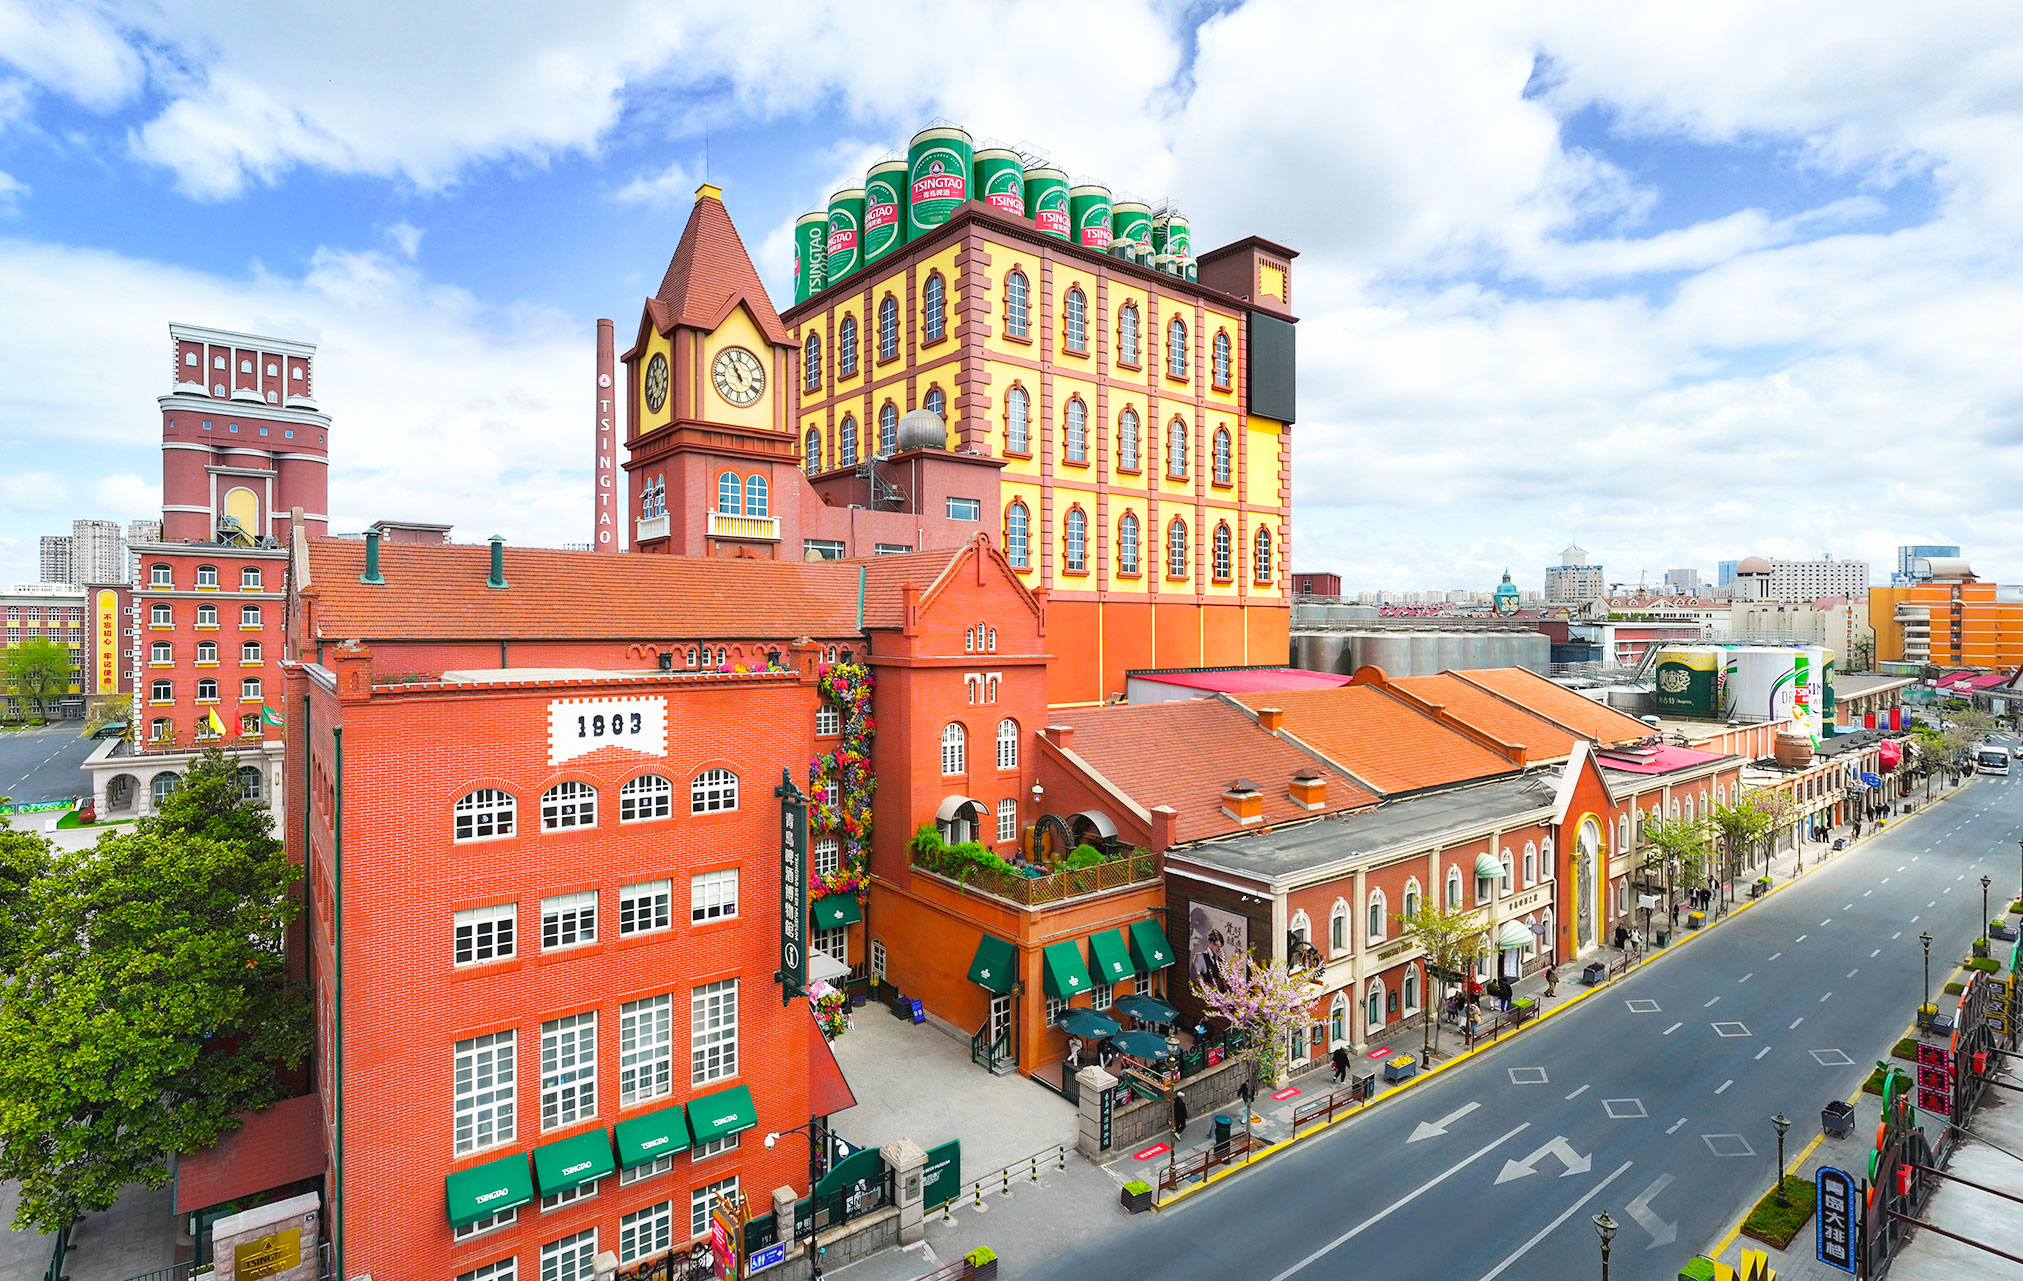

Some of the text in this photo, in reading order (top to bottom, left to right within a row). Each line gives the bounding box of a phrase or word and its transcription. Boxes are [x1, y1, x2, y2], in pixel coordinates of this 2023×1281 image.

[914, 178, 963, 193] TSINGTAO
[809, 227, 821, 296] TSINGTAO
[600, 399, 610, 544] TSINGTAO
[103, 613, 112, 684] 不忘初心 牢记使命
[578, 713, 641, 738] 1903
[712, 1113, 738, 1127] TSINGTAO
[641, 1136, 669, 1150] TSINGTAO
[562, 1160, 592, 1176] TSINGTAO
[475, 1187, 508, 1204] TSINGTAO
